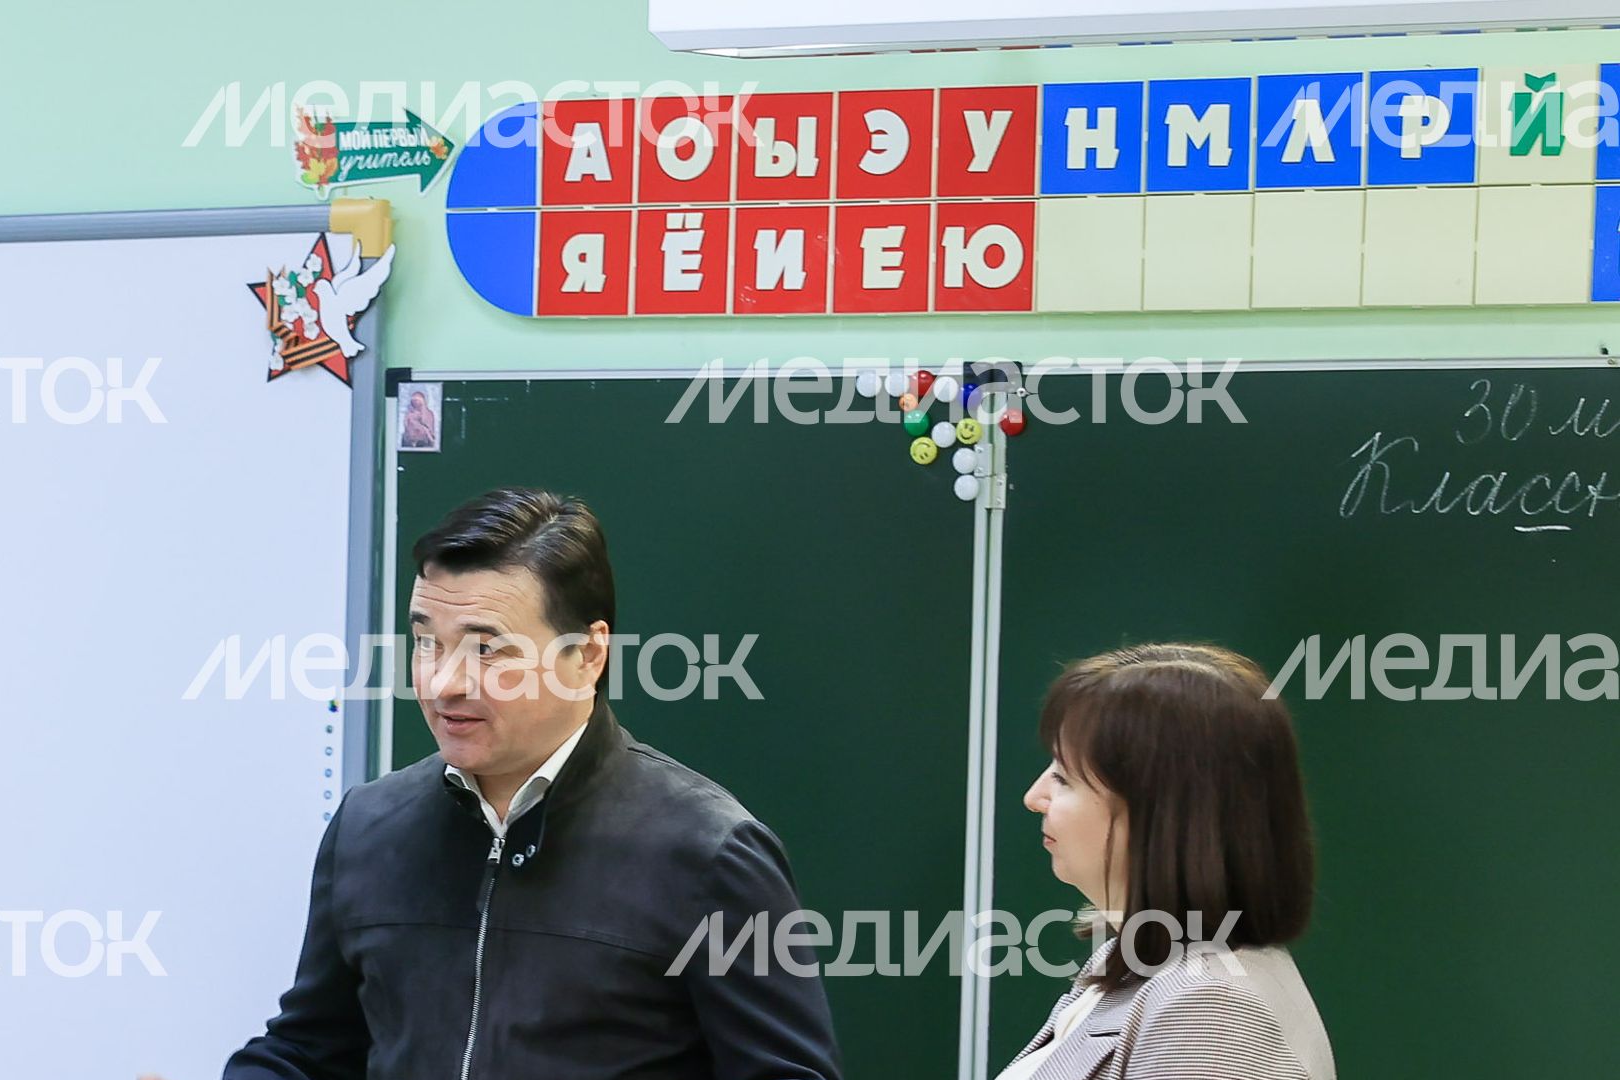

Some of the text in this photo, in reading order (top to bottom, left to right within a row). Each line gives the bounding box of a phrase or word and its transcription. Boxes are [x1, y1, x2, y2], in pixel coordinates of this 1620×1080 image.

[564, 72, 1566, 182] А О Ы Э У Н М Л Р Й
[560, 212, 1025, 293] Я Ё И Е Ю
[1455, 378, 1538, 445] 30
